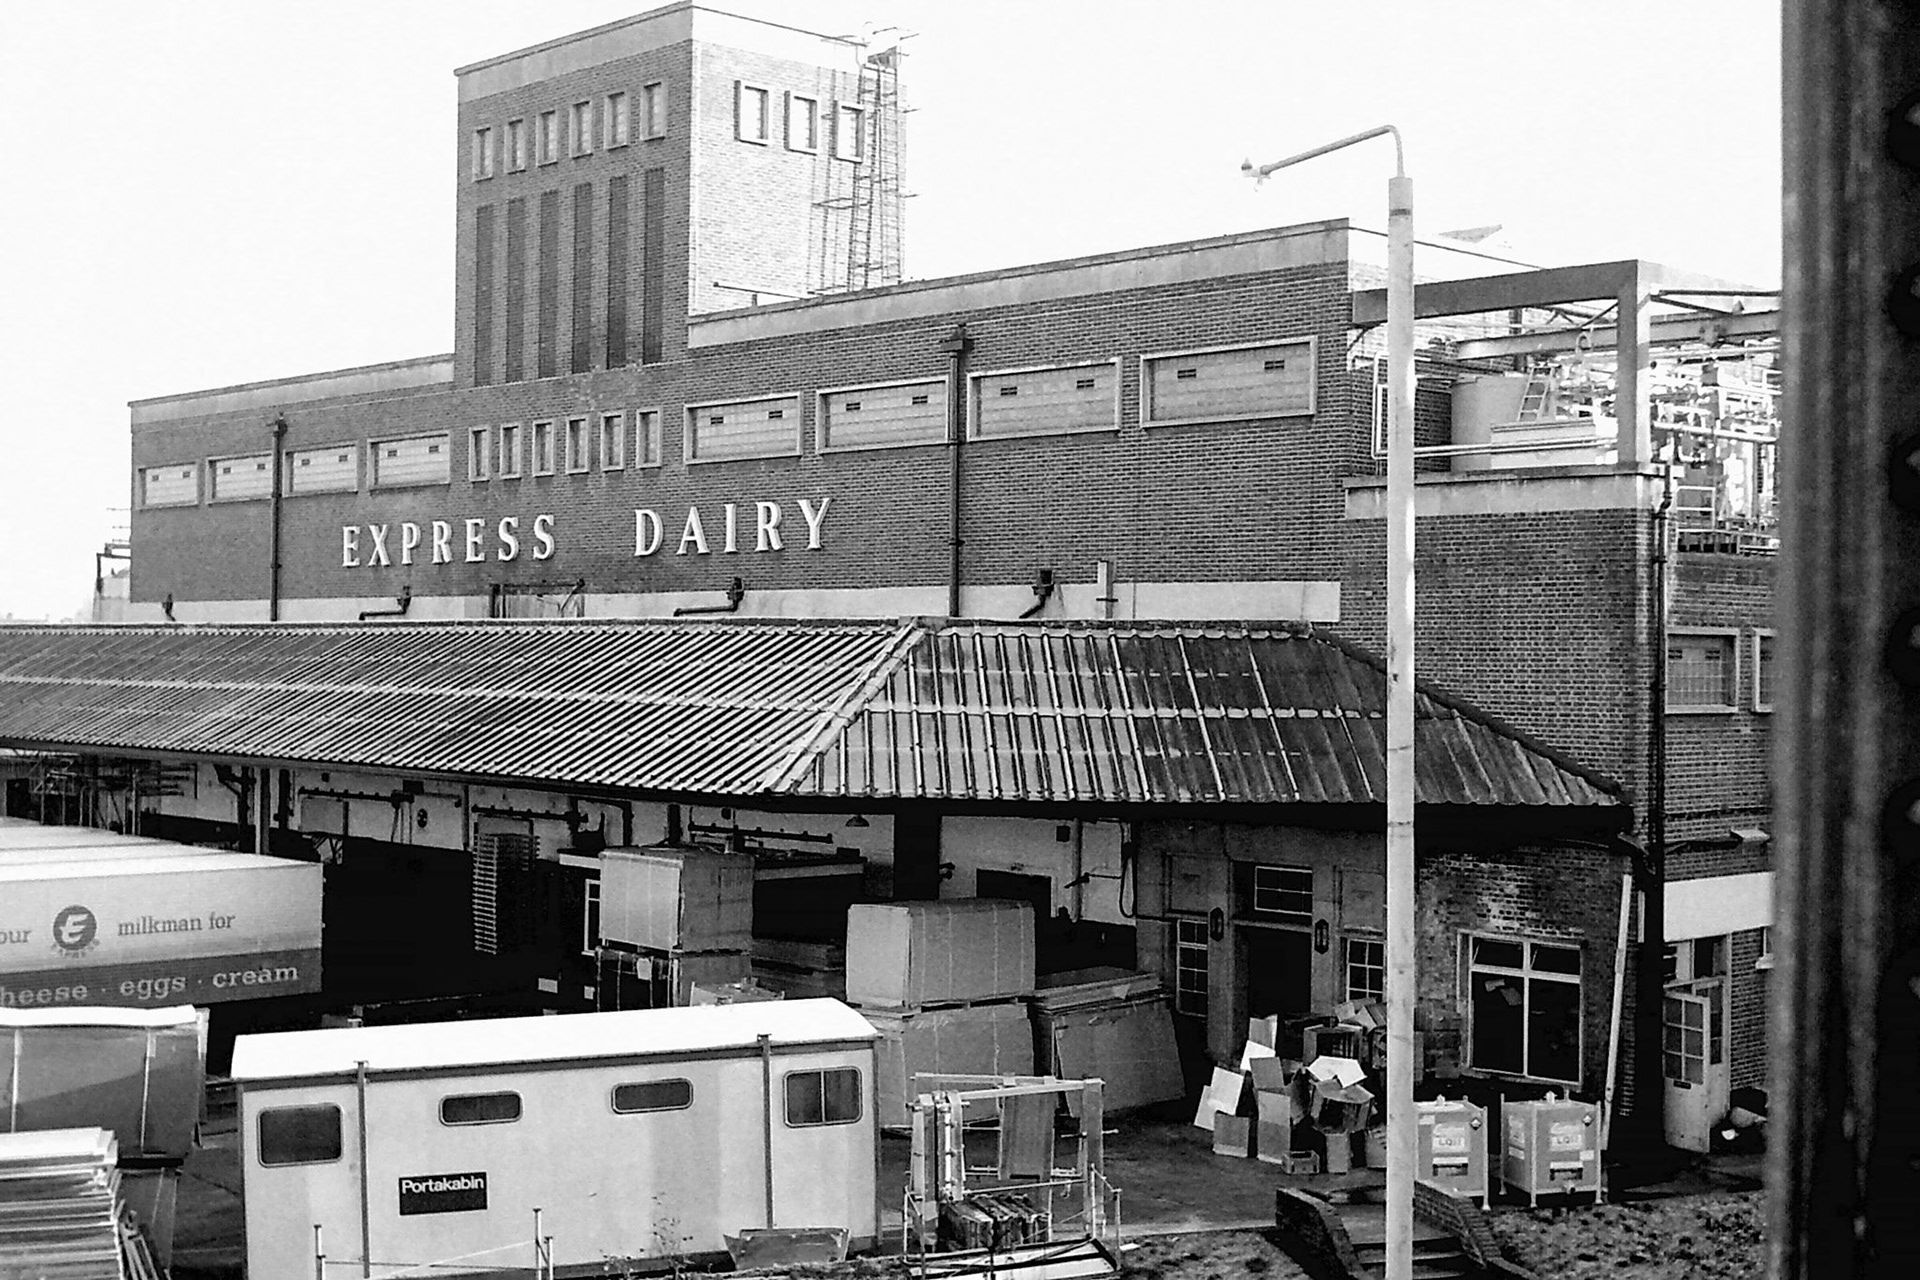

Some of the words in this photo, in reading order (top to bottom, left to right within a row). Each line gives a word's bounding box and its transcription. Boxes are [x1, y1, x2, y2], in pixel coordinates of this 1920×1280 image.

[342, 514, 555, 567] EXPRESS
[634, 498, 832, 557] DAIRY
[118, 915, 202, 937] milkman
[208, 912, 236, 930] for
[119, 976, 186, 999] eggs
[212, 966, 298, 988] cream
[401, 1176, 484, 1194] Portakabin
